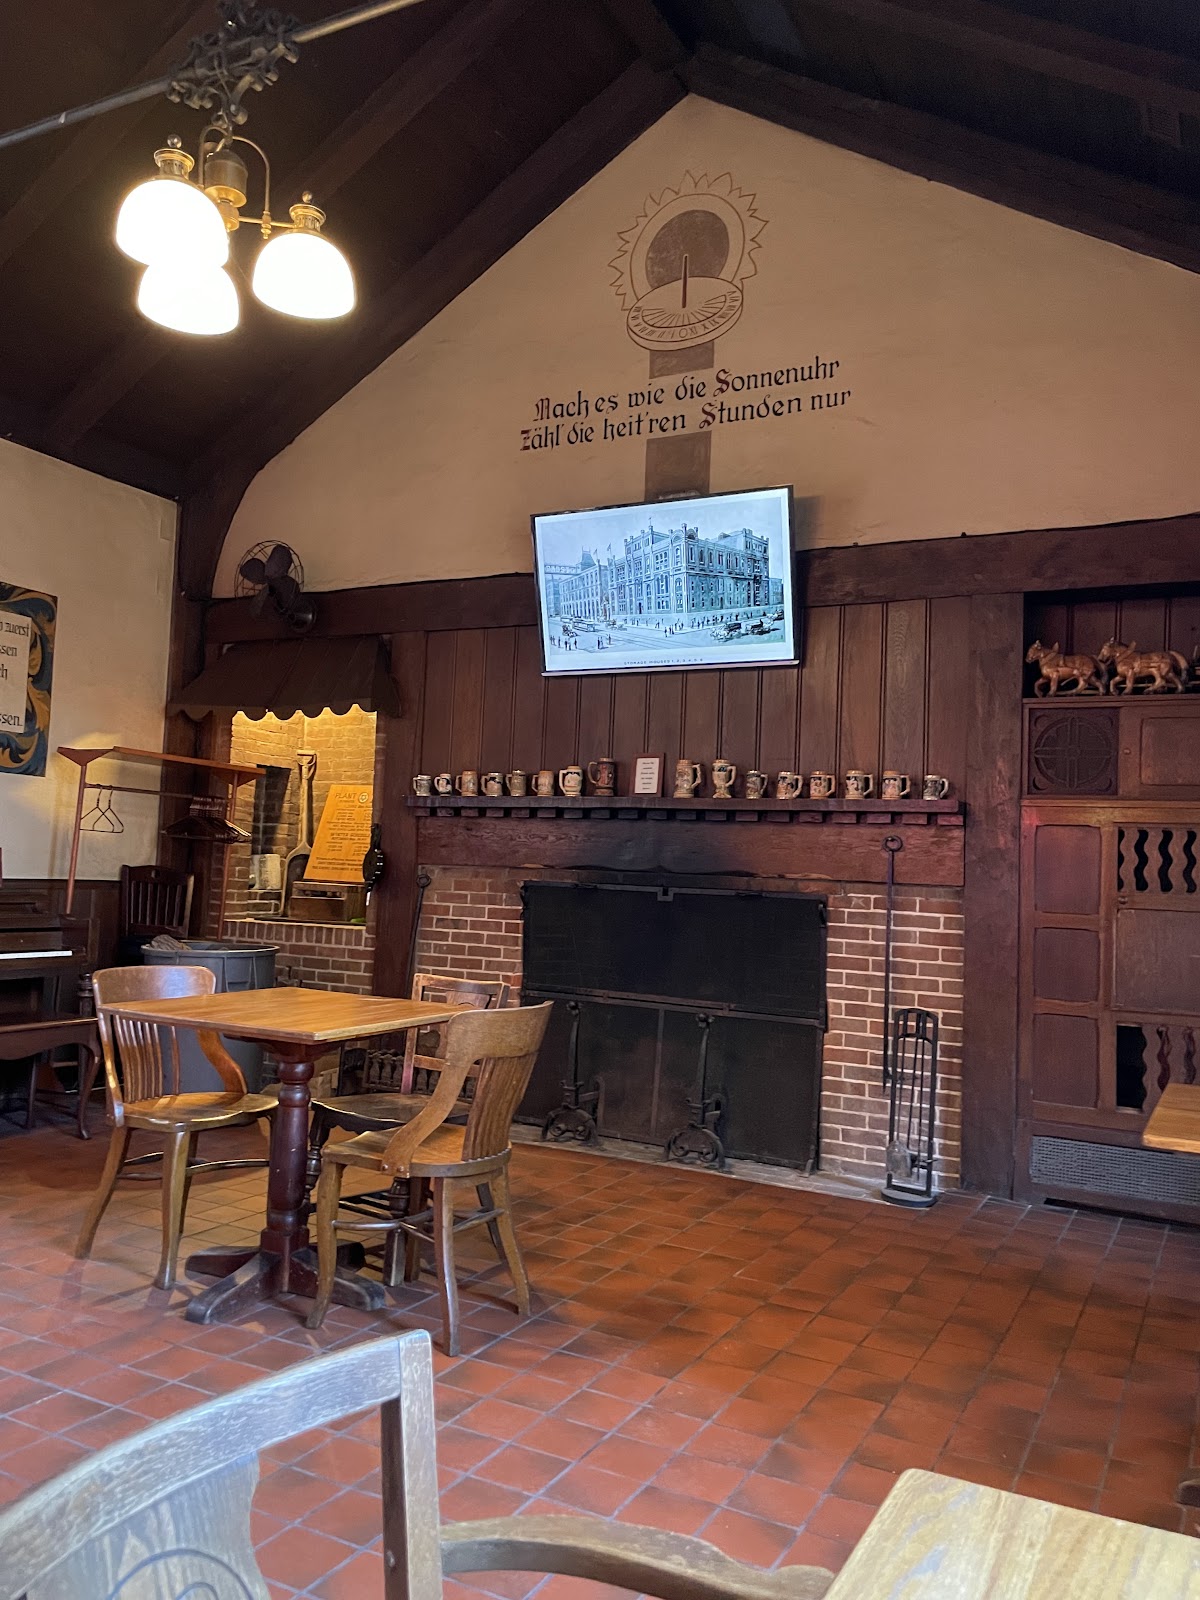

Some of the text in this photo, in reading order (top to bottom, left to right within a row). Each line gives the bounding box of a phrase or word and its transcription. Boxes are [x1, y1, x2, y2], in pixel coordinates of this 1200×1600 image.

[533, 355, 840, 422] Mach es wie die Sonnenuhr
[567, 421, 595, 445] die
[603, 411, 686, 442] heit'ren
[698, 393, 802, 430] Stunden
[810, 389, 852, 411] nur
